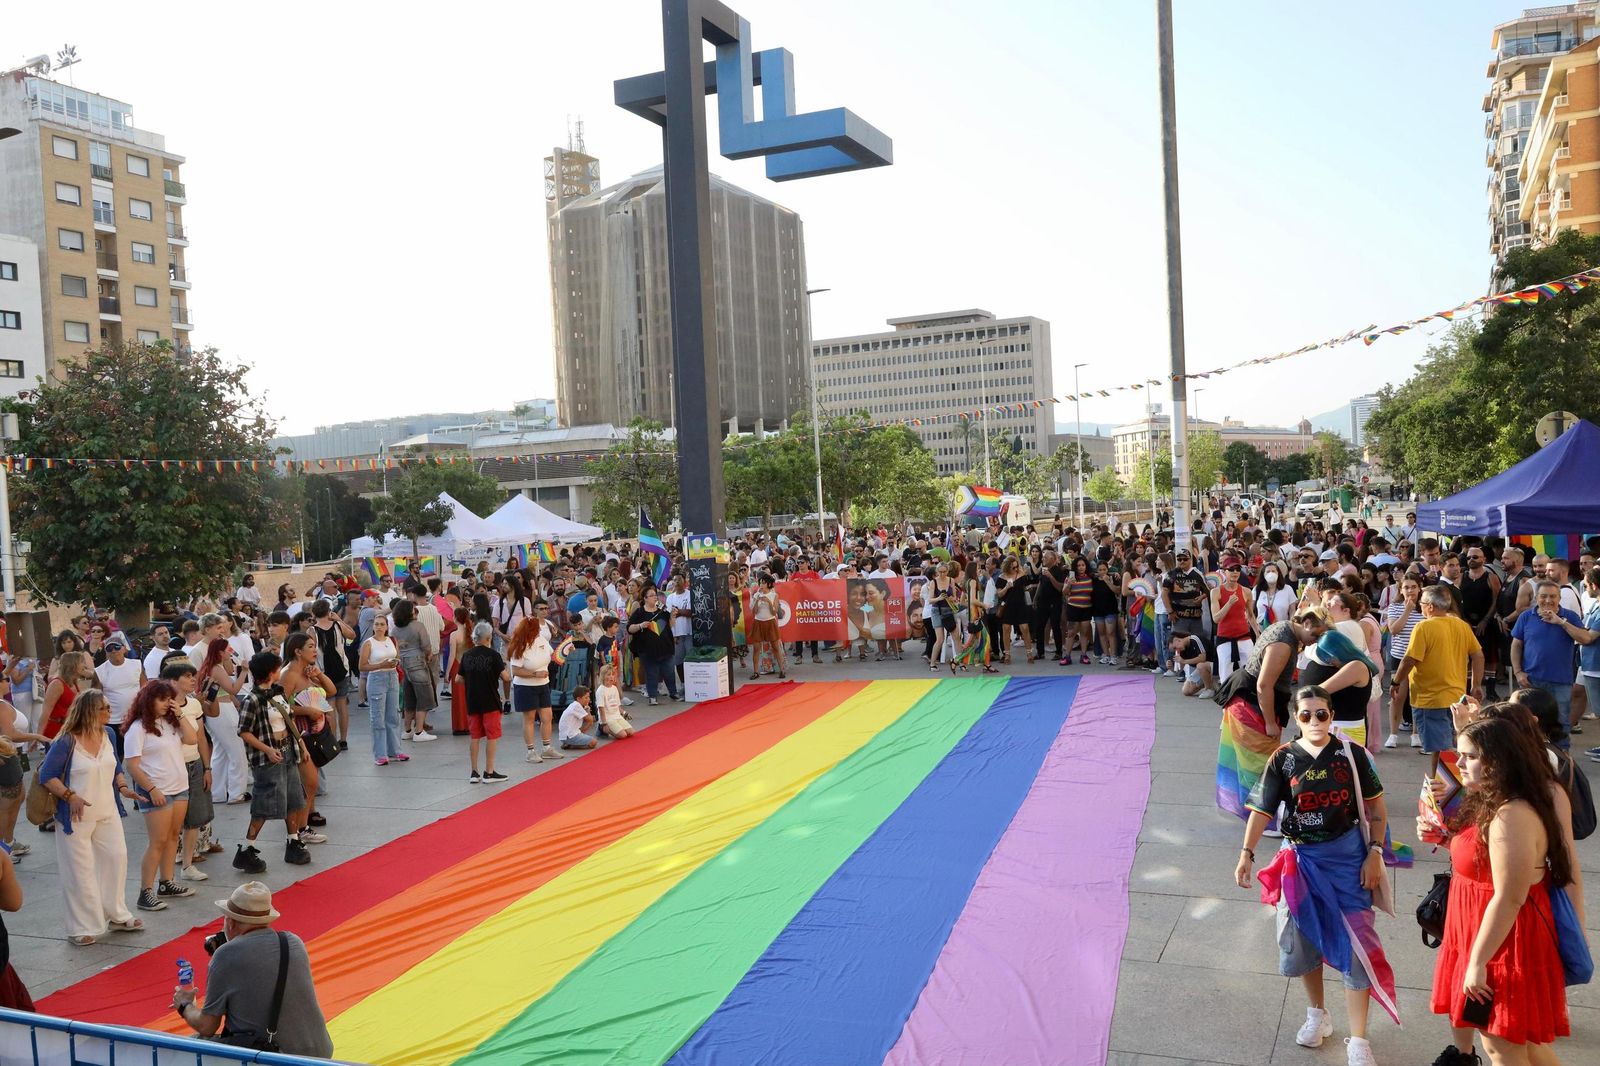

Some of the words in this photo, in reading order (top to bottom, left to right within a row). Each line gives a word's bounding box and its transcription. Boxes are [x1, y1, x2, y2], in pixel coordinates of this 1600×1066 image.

[796, 600, 824, 610] AÑOS
[827, 600, 841, 609] DE
[796, 616, 842, 624] IGUALITARIO
